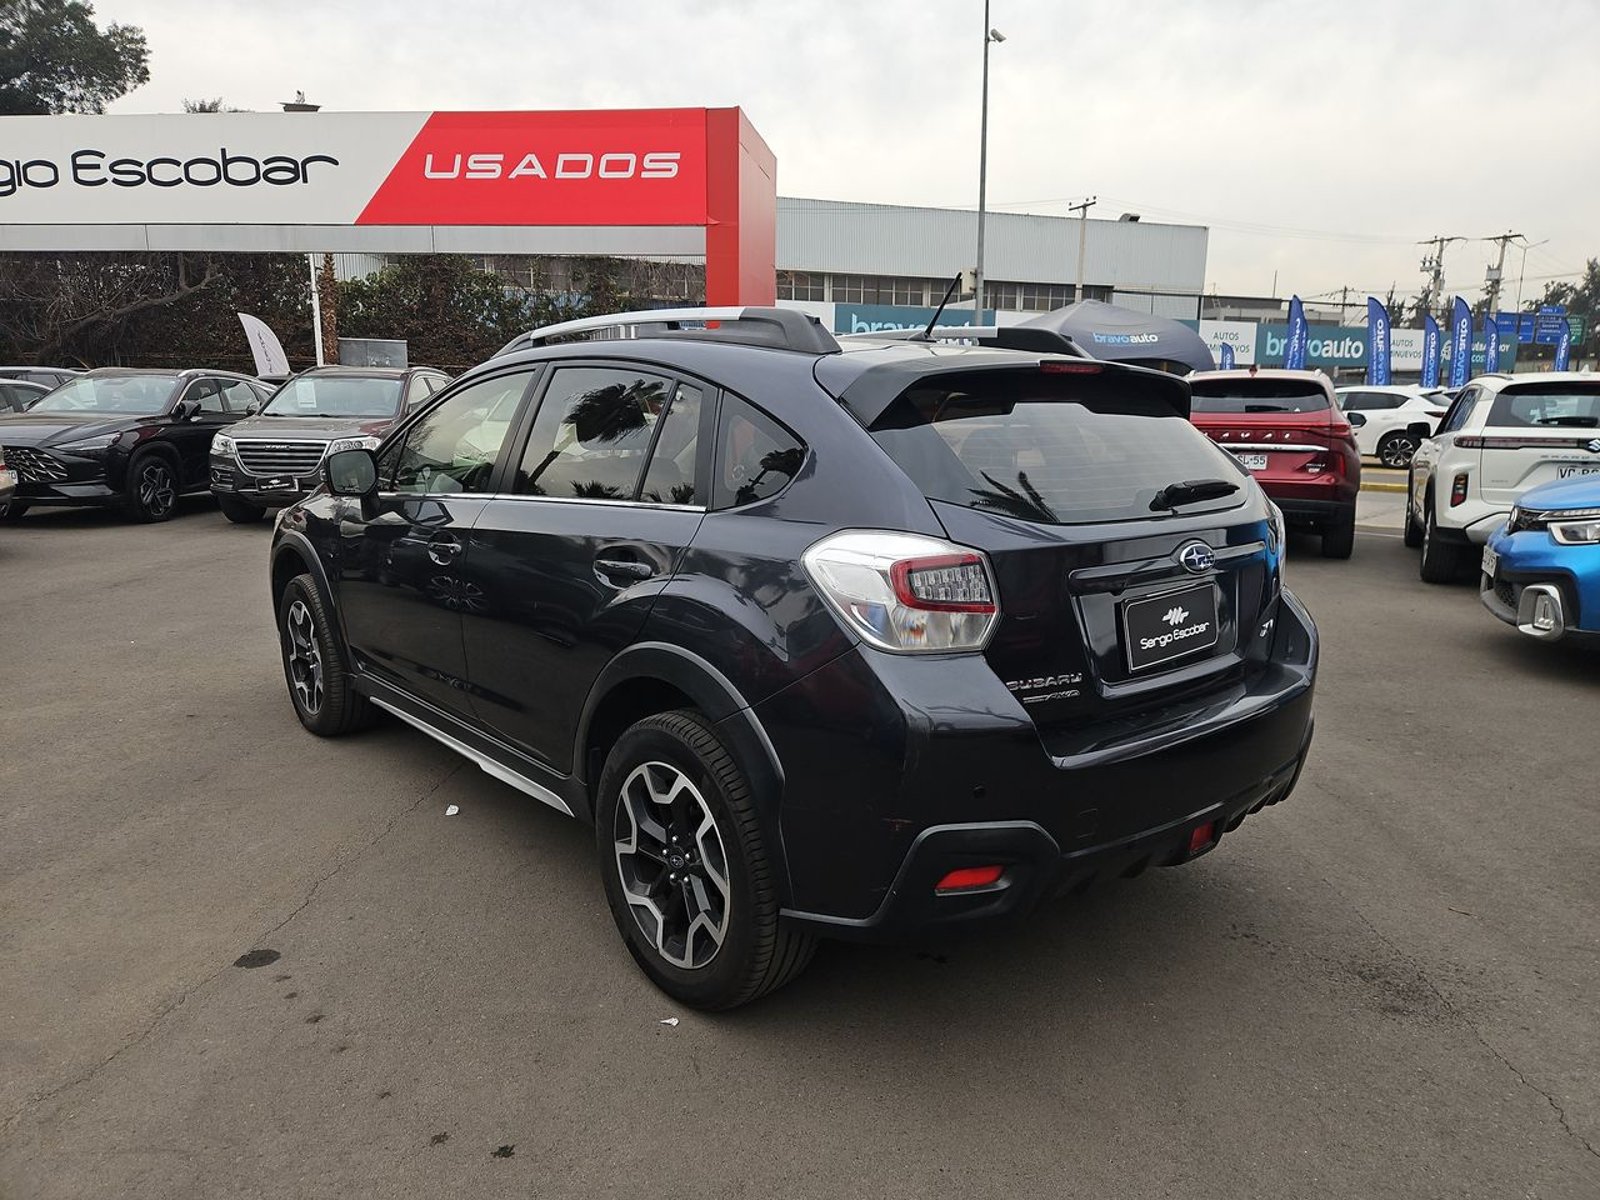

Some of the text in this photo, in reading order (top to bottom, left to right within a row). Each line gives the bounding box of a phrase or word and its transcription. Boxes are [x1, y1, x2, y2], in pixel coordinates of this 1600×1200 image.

[71, 147, 340, 188] Escobar
[424, 152, 681, 180] USADOS
[1093, 332, 1159, 344] bravoauto
[1213, 332, 1240, 341] AUTOS
[1173, 622, 1210, 641] Escobar
[1005, 672, 1083, 691] SUBARU
